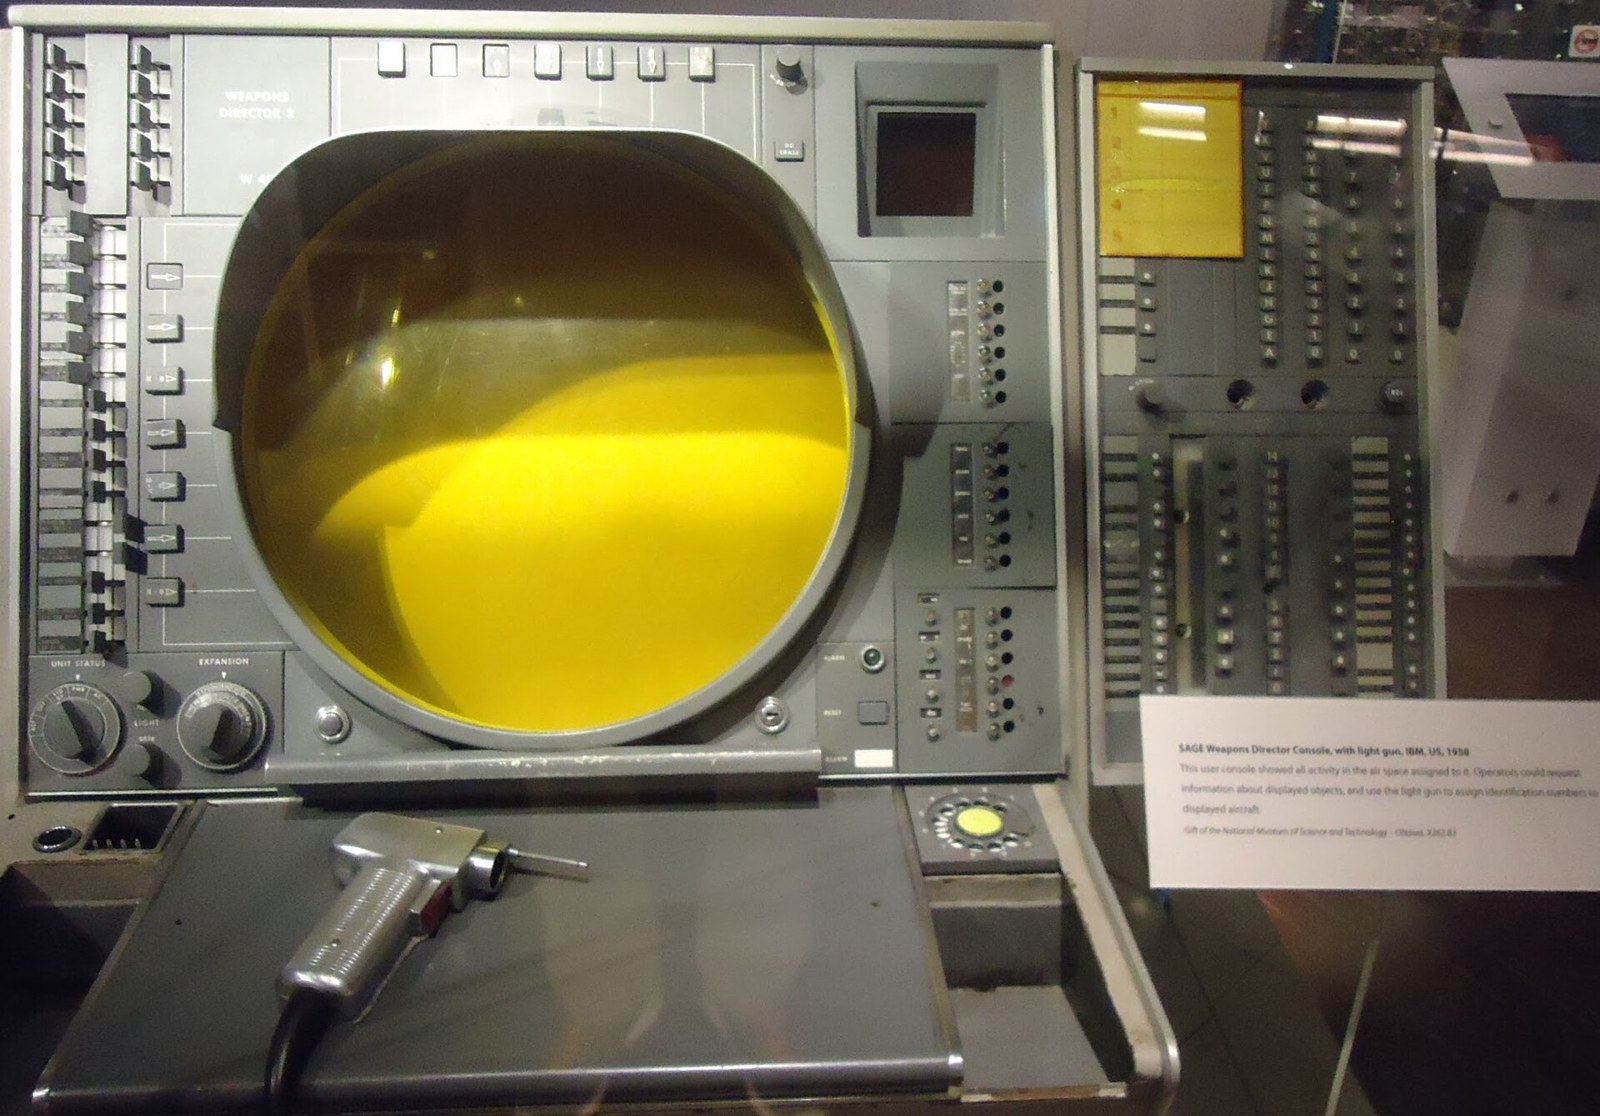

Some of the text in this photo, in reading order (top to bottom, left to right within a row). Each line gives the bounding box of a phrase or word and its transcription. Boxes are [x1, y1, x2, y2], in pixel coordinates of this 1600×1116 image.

[225, 91, 289, 102] WEAPONS
[219, 107, 280, 119] DIRECTOR
[240, 174, 253, 185] W
[51, 660, 71, 668] UNIT
[199, 657, 249, 666] EXPANSION
[134, 719, 159, 727] LIGHT
[1179, 744, 1470, 757] SAGE Weapons Director Console, with light gun, IBM, US, 1958
[1180, 763, 1198, 773] This
[1200, 765, 1220, 773] user
[1221, 764, 1256, 774] console
[1258, 765, 1293, 774] showed
[1295, 765, 1306, 774] all
[1308, 766, 1340, 777] activity
[1342, 766, 1352, 775] in
[1352, 766, 1367, 775] the
[1451, 768, 1461, 776] to
[1473, 767, 1519, 778] Operators
[1520, 767, 1545, 777] could
[1181, 784, 1234, 794] information
[1237, 784, 1263, 794] about
[1265, 785, 1308, 797] displayed
[1347, 786, 1364, 795] and
[1366, 787, 1382, 795] use
[1384, 786, 1399, 795] the
[1401, 786, 1422, 798] light
[1423, 788, 1442, 798] gun
[1443, 787, 1454, 796] to
[1182, 804, 1226, 815] displayed
[1184, 826, 1198, 834] Gift
[1199, 826, 1209, 834] of
[1209, 827, 1221, 835] the
[1222, 827, 1256, 835] National
[1256, 828, 1289, 836] Museum
[1300, 827, 1327, 836] Science
[1328, 828, 1344, 836] and
[1345, 828, 1388, 838] Technology
